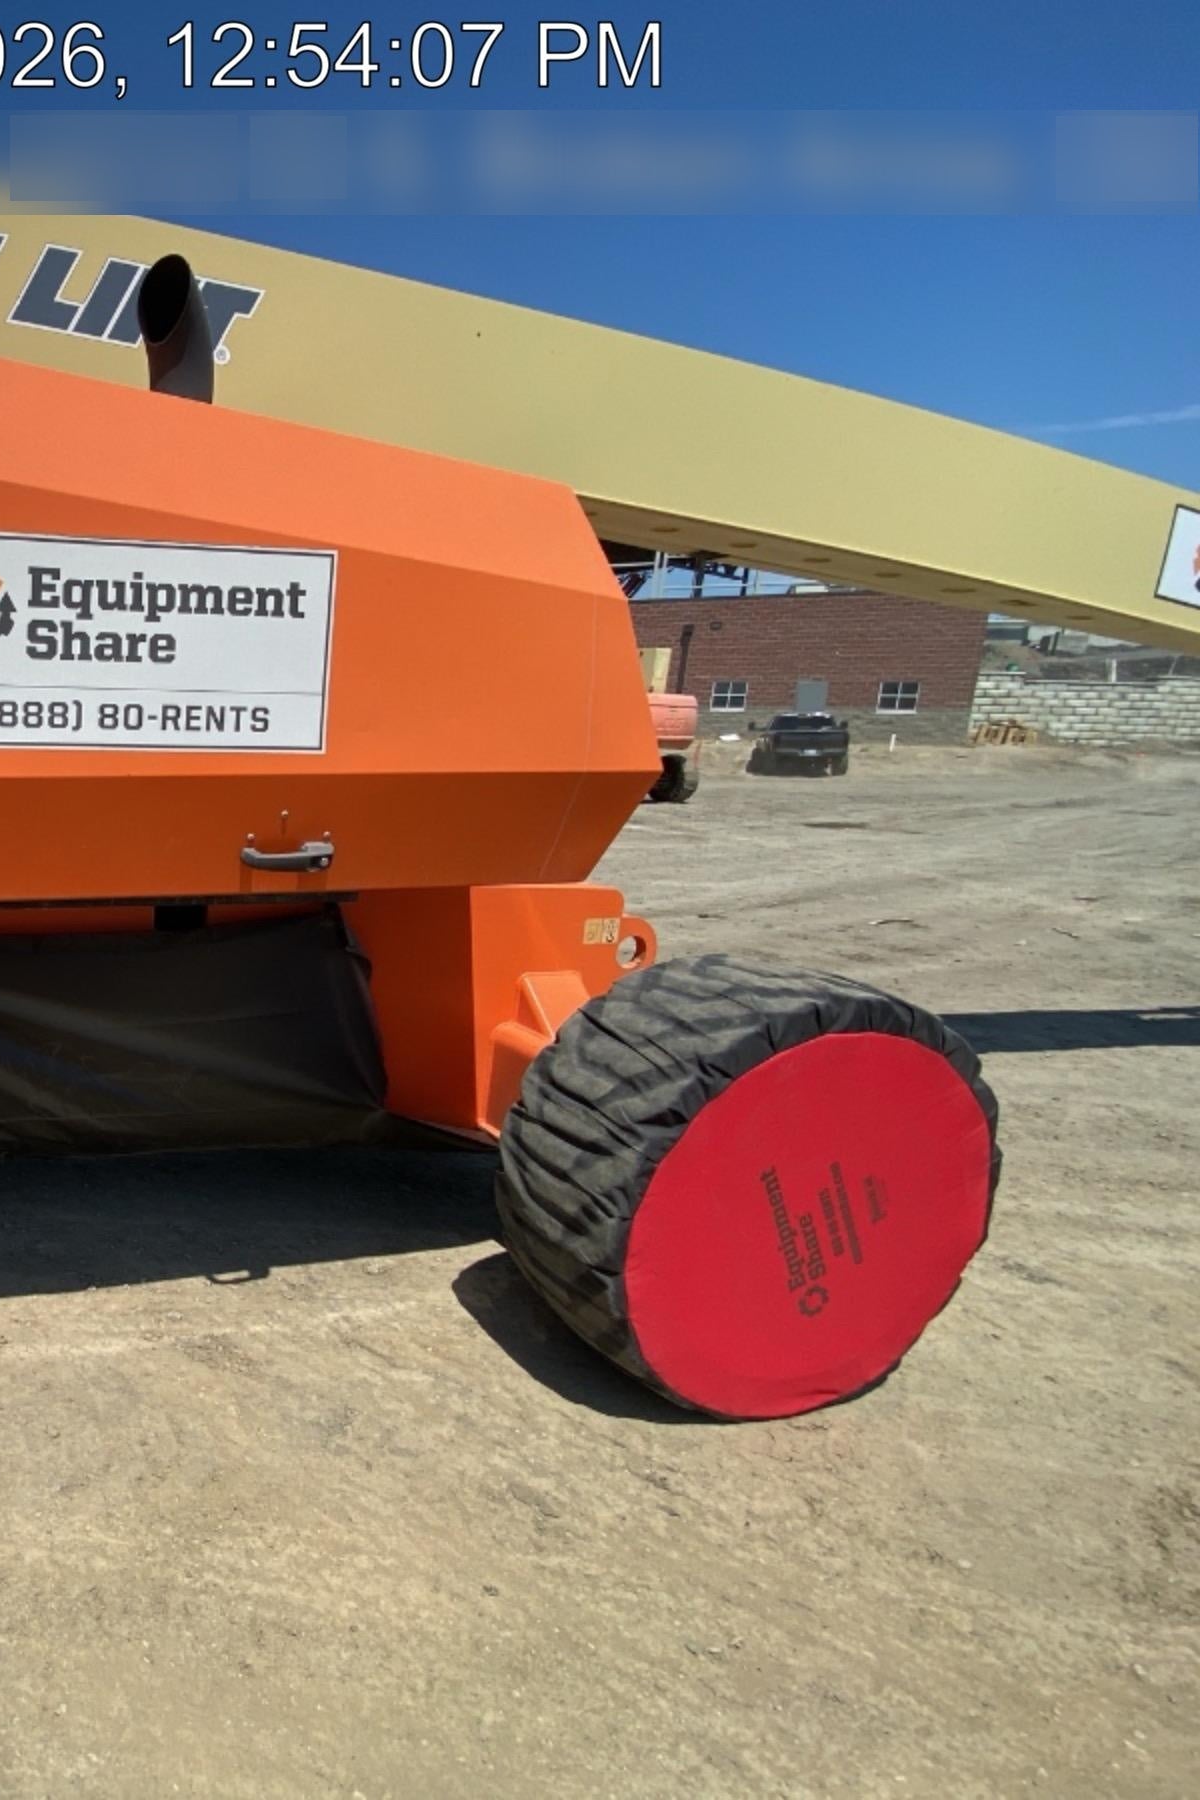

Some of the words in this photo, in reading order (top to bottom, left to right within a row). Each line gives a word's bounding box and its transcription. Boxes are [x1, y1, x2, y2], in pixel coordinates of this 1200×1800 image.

[28, 566, 306, 622] Equipment
[25, 619, 177, 664] Share
[98, 702, 271, 733] 80-RENTS
[759, 1165, 806, 1292] Equipment
[799, 1212, 827, 1281] Share
